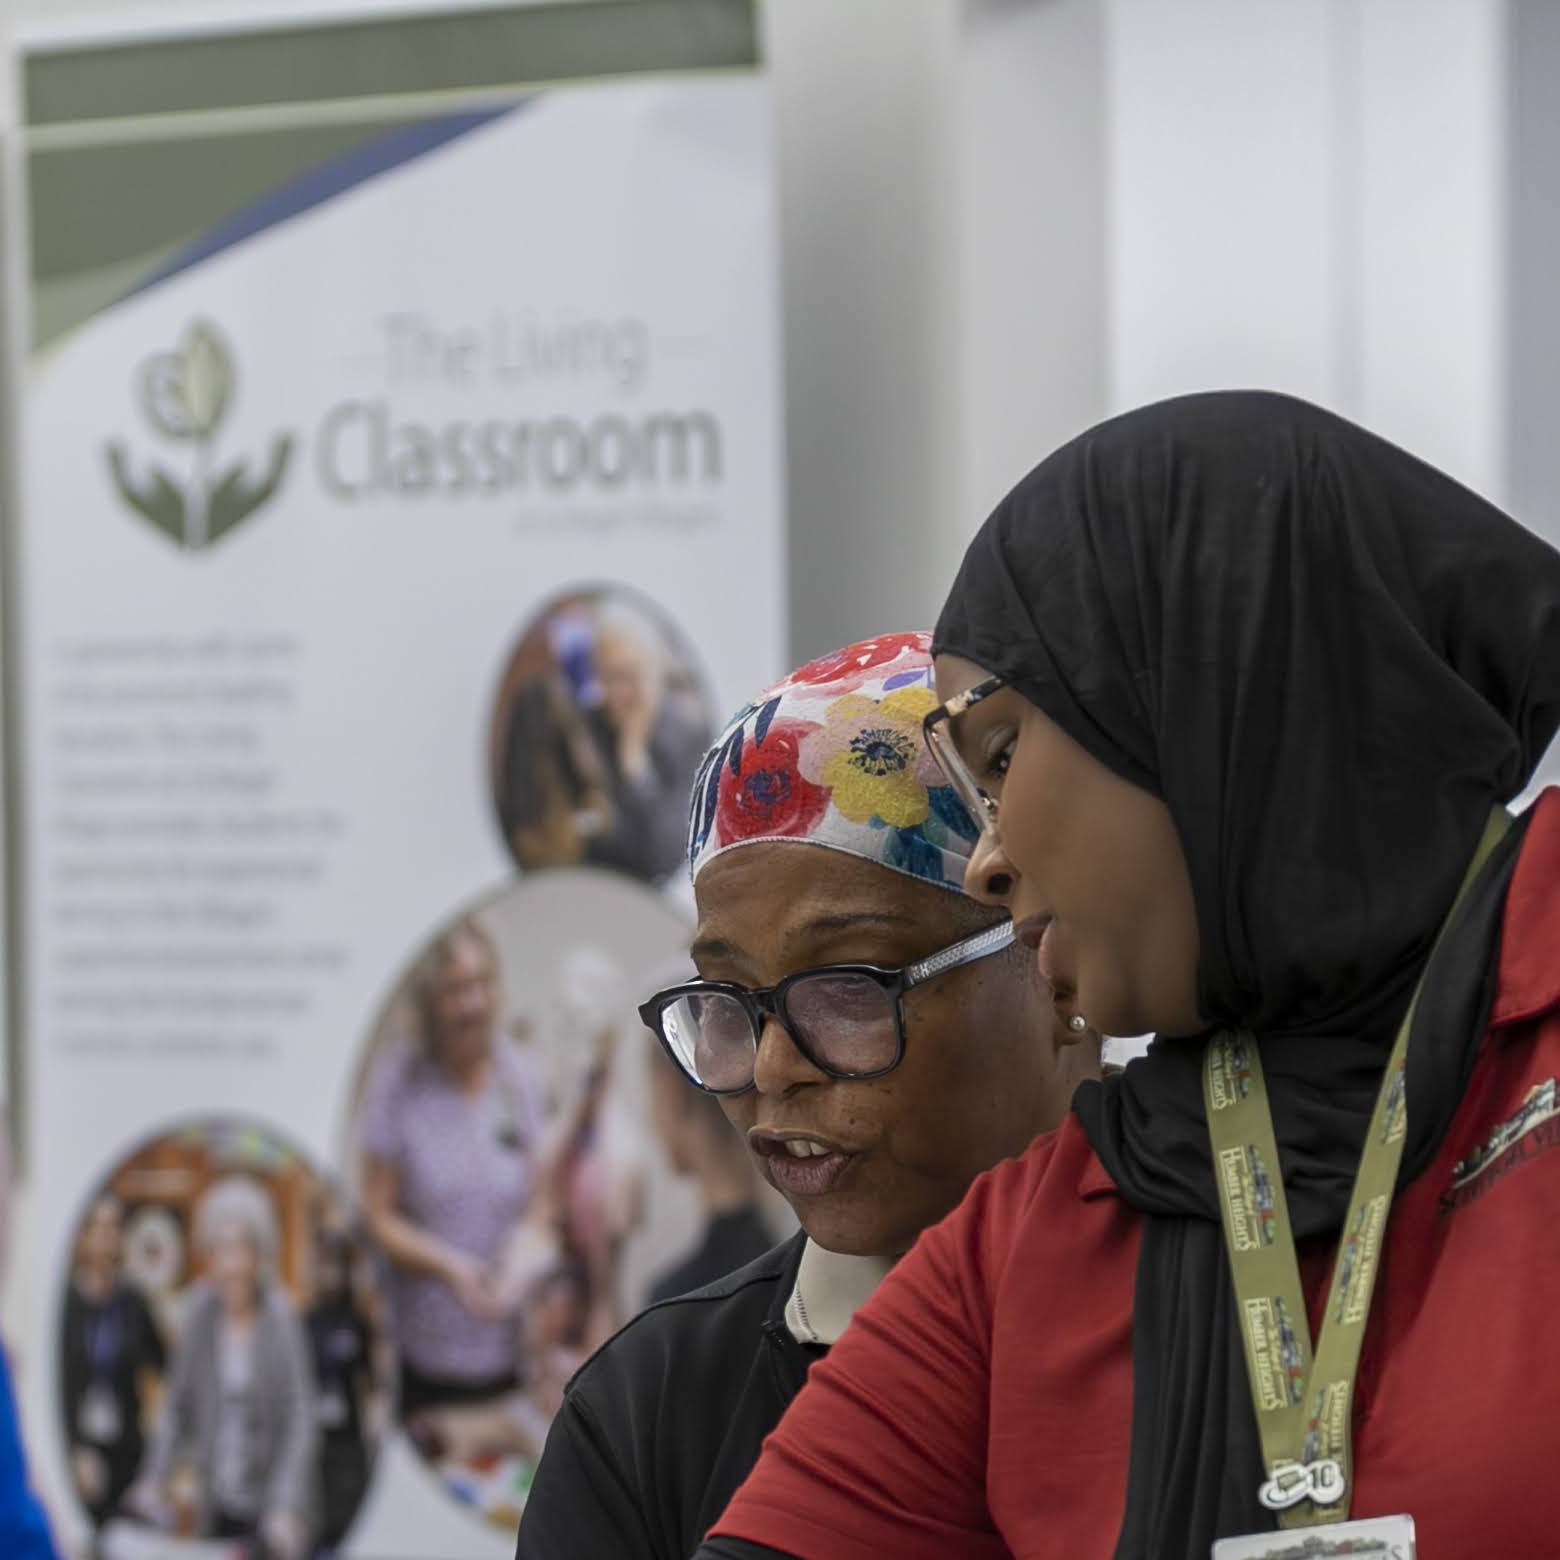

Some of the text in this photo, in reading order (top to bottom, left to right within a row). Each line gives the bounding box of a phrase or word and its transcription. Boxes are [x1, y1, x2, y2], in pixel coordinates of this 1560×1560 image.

[378, 308, 650, 396] The Living
[316, 398, 724, 504] Classroom
